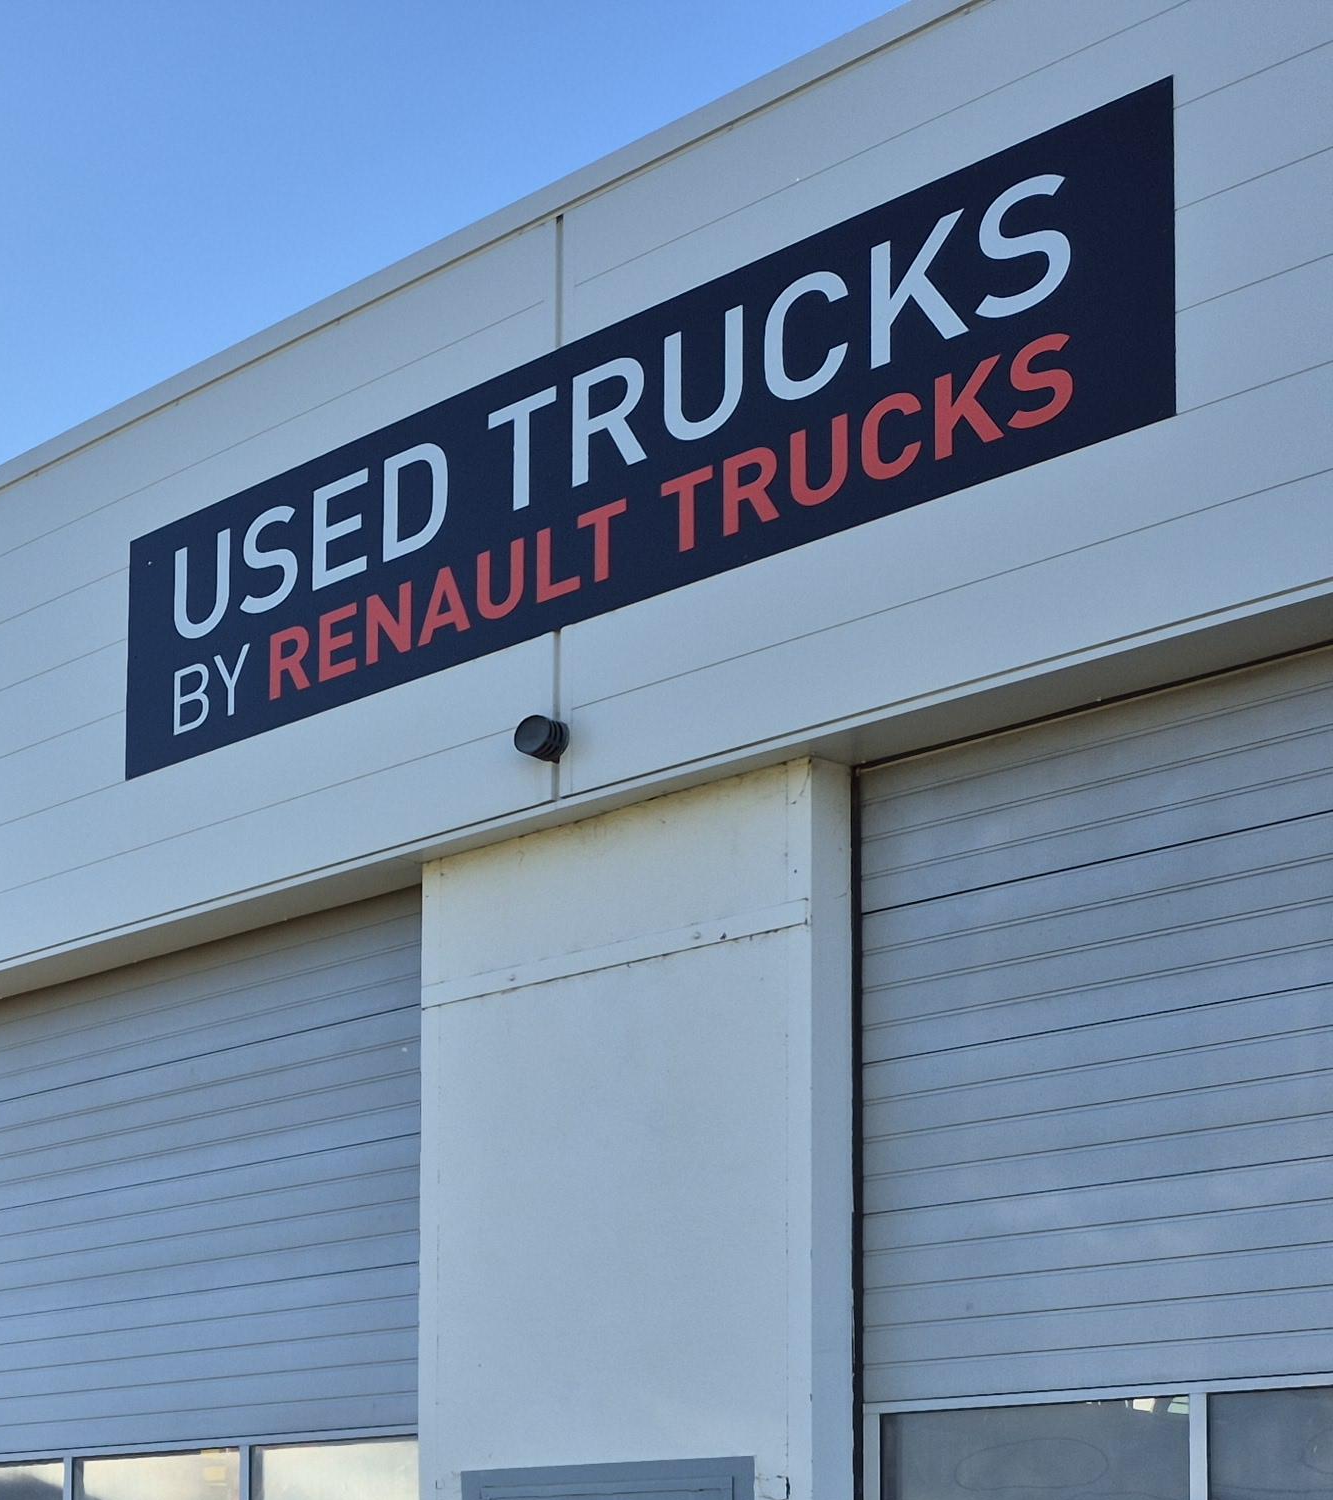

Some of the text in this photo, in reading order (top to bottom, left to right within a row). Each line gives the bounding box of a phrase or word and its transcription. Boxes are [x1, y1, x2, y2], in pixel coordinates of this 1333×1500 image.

[172, 173, 1072, 640] USED TRUCKS
[172, 332, 1075, 735] BY RENAULT TRUCKS
